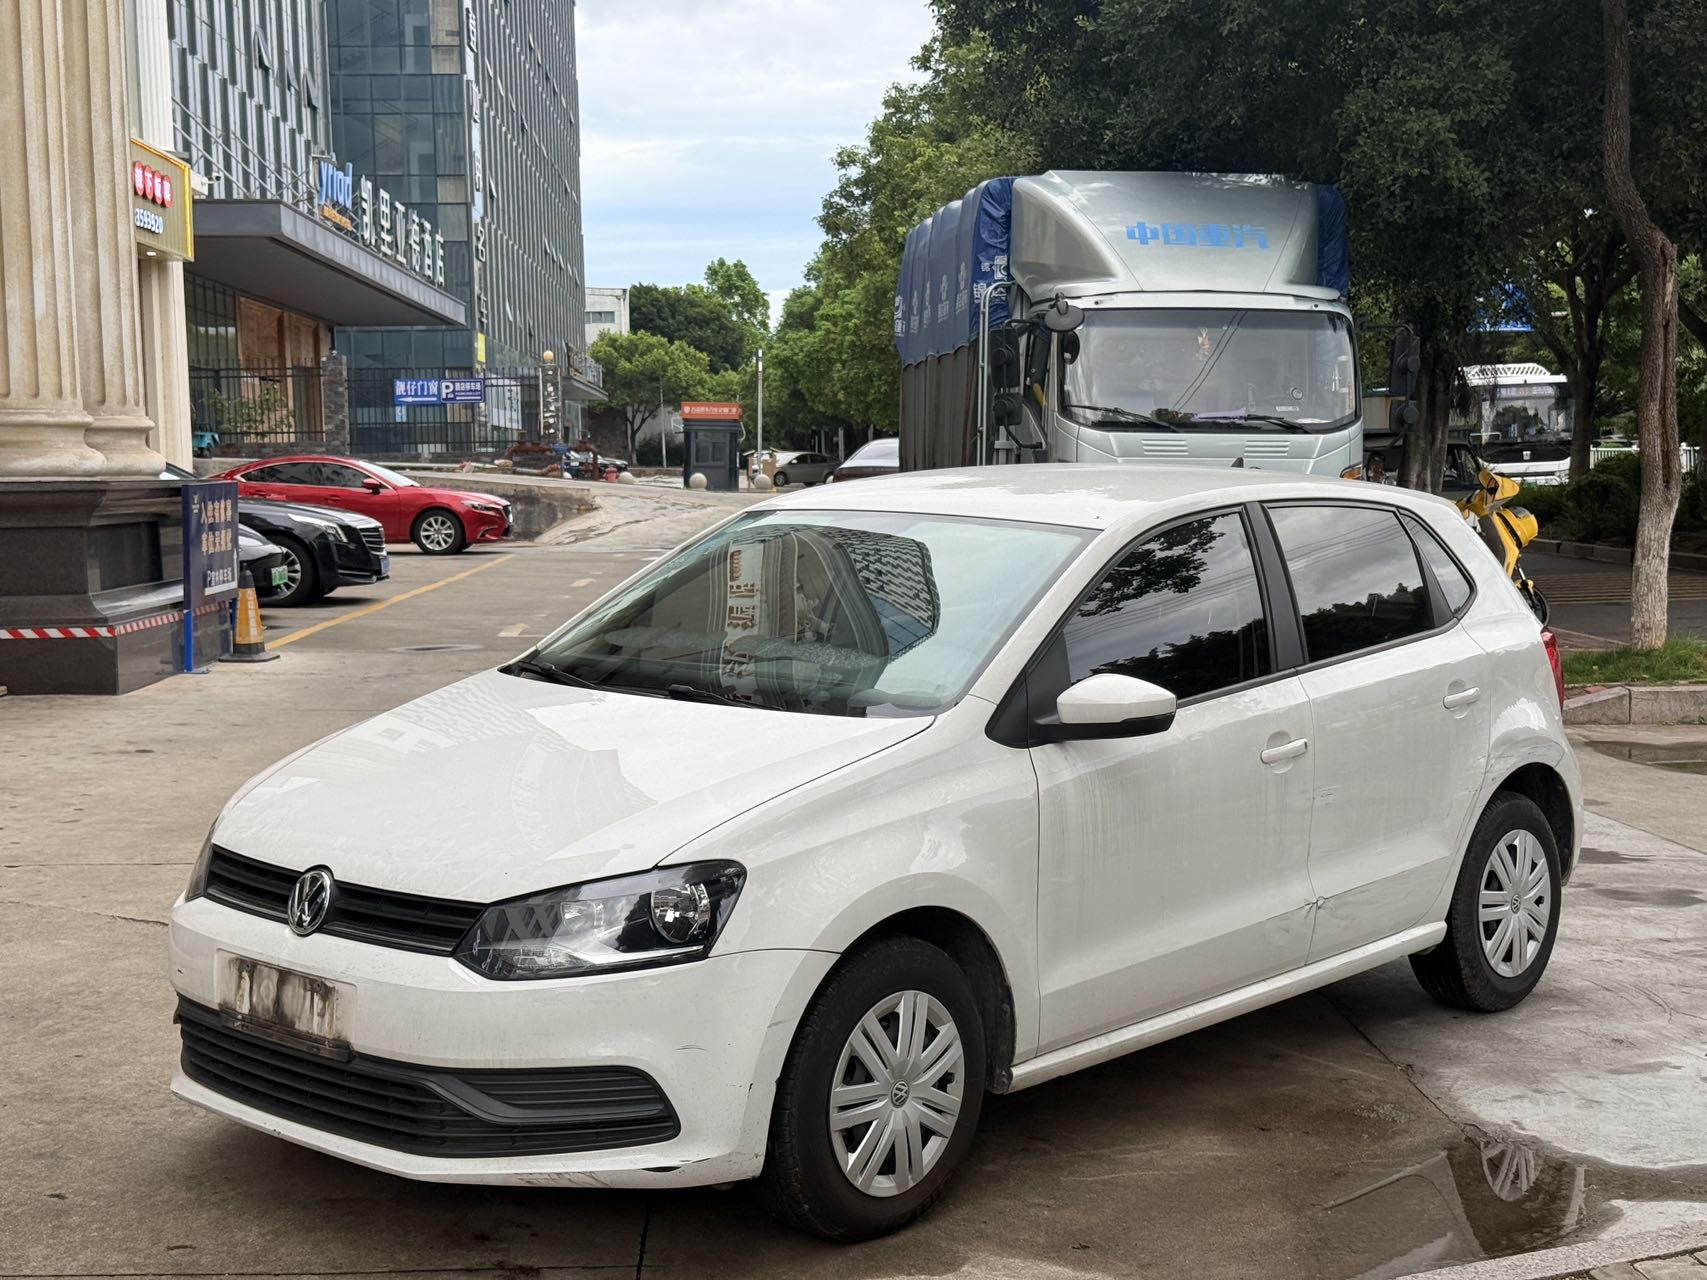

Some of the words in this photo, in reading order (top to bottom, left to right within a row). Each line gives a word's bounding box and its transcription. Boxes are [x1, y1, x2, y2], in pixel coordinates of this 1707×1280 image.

[318, 152, 353, 211] yriad
[1125, 220, 1269, 249] 中国重汽
